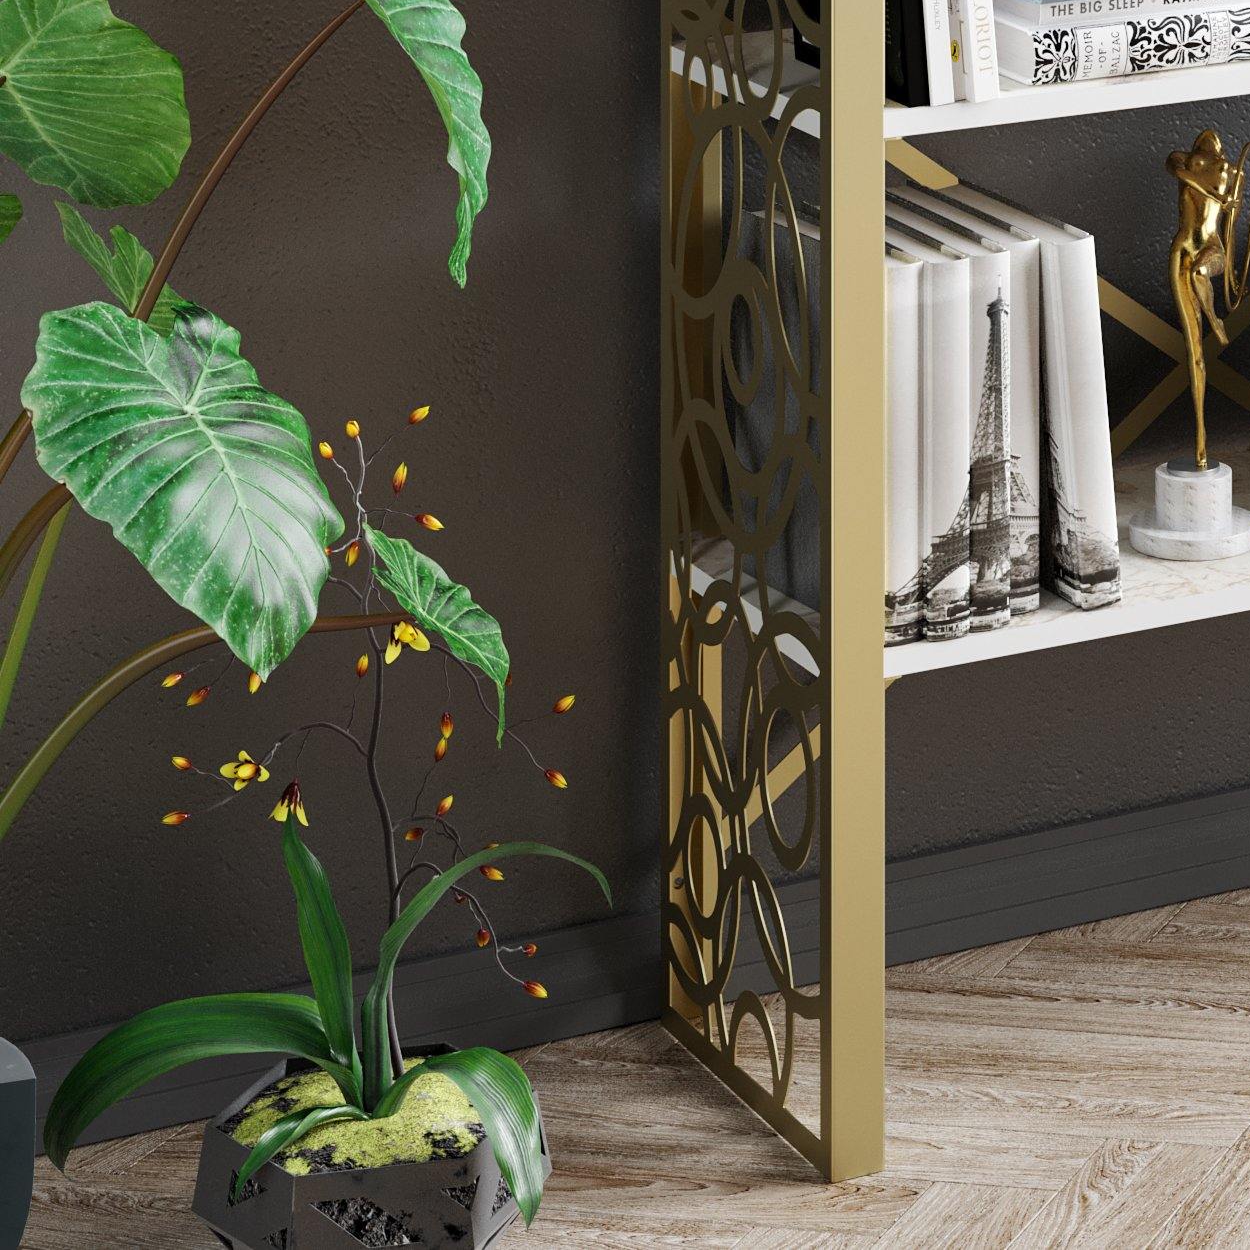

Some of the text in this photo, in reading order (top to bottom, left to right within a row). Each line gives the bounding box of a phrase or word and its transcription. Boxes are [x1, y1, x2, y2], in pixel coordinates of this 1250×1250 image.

[1050, 3, 1076, 17] THE
[1079, 0, 1103, 14] BIG
[1081, 30, 1092, 78] MEMOIR
[1109, 30, 1120, 75] BALZAC
